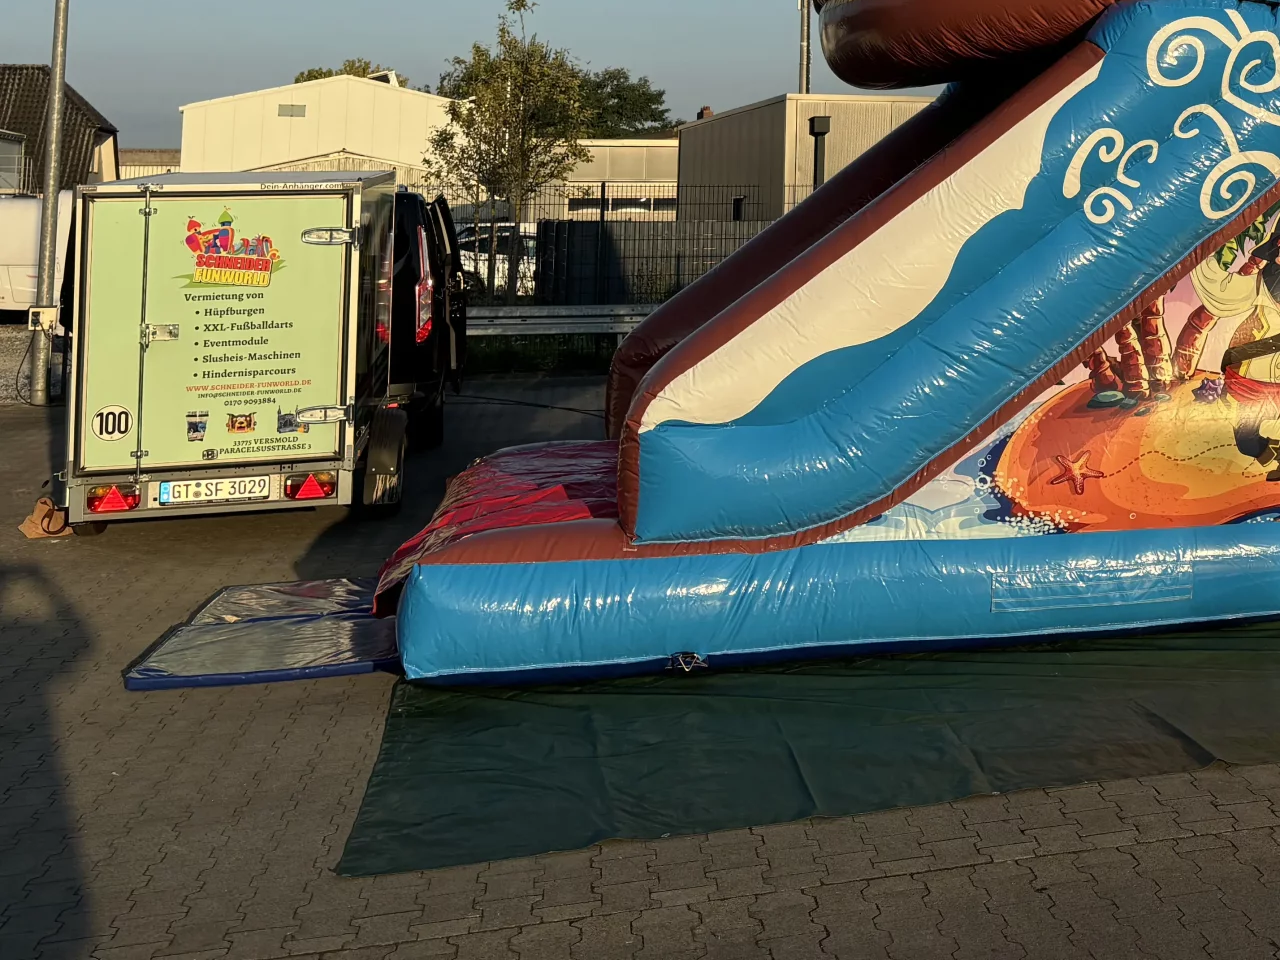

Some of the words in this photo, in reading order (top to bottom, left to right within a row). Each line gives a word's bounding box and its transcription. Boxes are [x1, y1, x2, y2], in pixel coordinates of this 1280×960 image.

[260, 182, 343, 191] Dein-Anhänger.com
[195, 253, 272, 272] SCHNEIDER
[194, 267, 270, 286] FUNWORLD
[184, 292, 244, 302] Vermietung
[245, 292, 264, 300] von
[204, 306, 265, 318] Hüpfburgen
[203, 320, 294, 332] XXL-Fußballdarts
[203, 336, 269, 348] Eventmodule
[202, 351, 301, 363] Slusheis-Maschinen
[202, 367, 296, 379] Hindernisparcours
[185, 379, 312, 392] WWW.SCHNEIDER-FUNWORLD.DE
[197, 387, 302, 399] INFO@SCHNEIDER-FUNWORLD.DE
[244, 397, 276, 406] 9093884
[95, 410, 129, 436] 100
[233, 439, 252, 447] 33775
[253, 436, 299, 445] VERSMOLD
[219, 443, 306, 455] PARACELSUSSTRASSE
[172, 484, 192, 499] GT
[204, 481, 224, 497] SF
[228, 478, 267, 496] 3029
